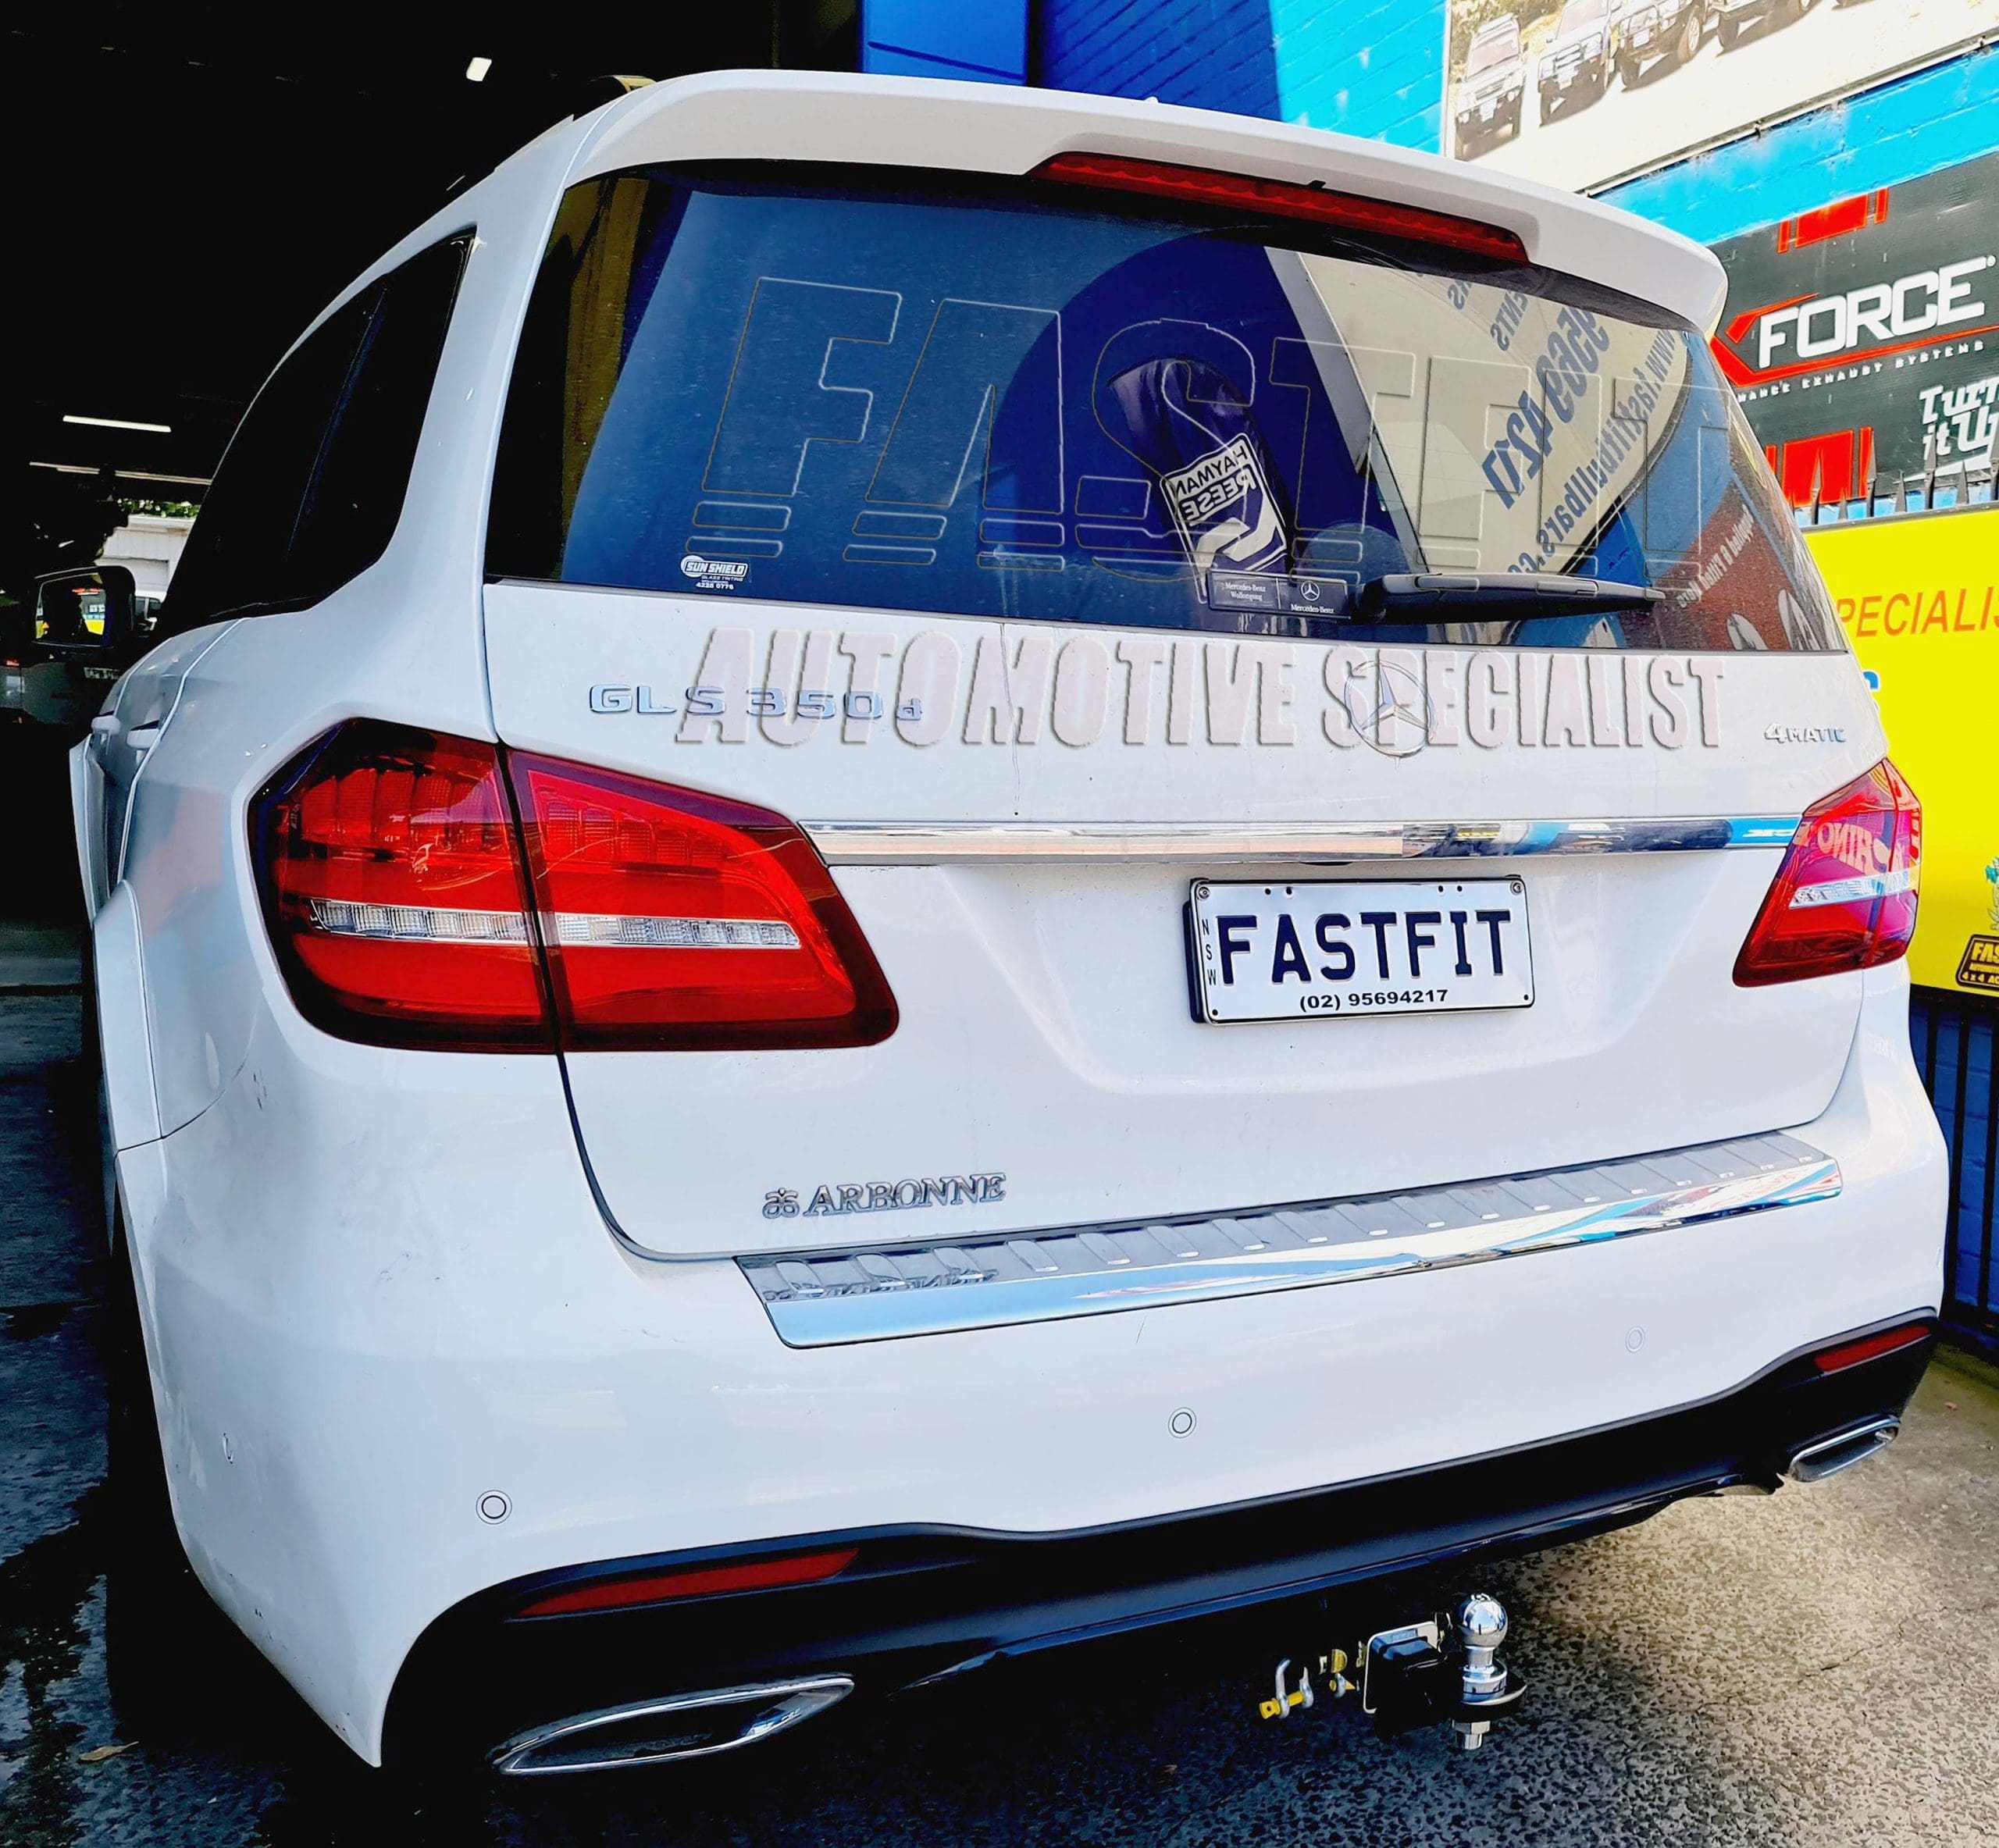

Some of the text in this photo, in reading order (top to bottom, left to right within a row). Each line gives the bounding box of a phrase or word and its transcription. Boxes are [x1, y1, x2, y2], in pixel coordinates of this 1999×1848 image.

[1758, 255, 1987, 369] FORCE
[1801, 361, 1883, 389] EXHAUST
[1895, 340, 1984, 369] SYSTEMS
[686, 561, 745, 575] SUN SHIELD
[1291, 604, 1334, 614] Mercedes-Benz
[1837, 586, 1999, 638] PECIALI
[589, 683, 727, 717] GLS
[745, 687, 882, 721] 350
[1764, 722, 1847, 744] 4MATIC
[1216, 910, 1511, 985] FASTFIT
[1299, 989, 1448, 1013] (02) 95694217
[803, 1173, 1007, 1216] ARBONNE
